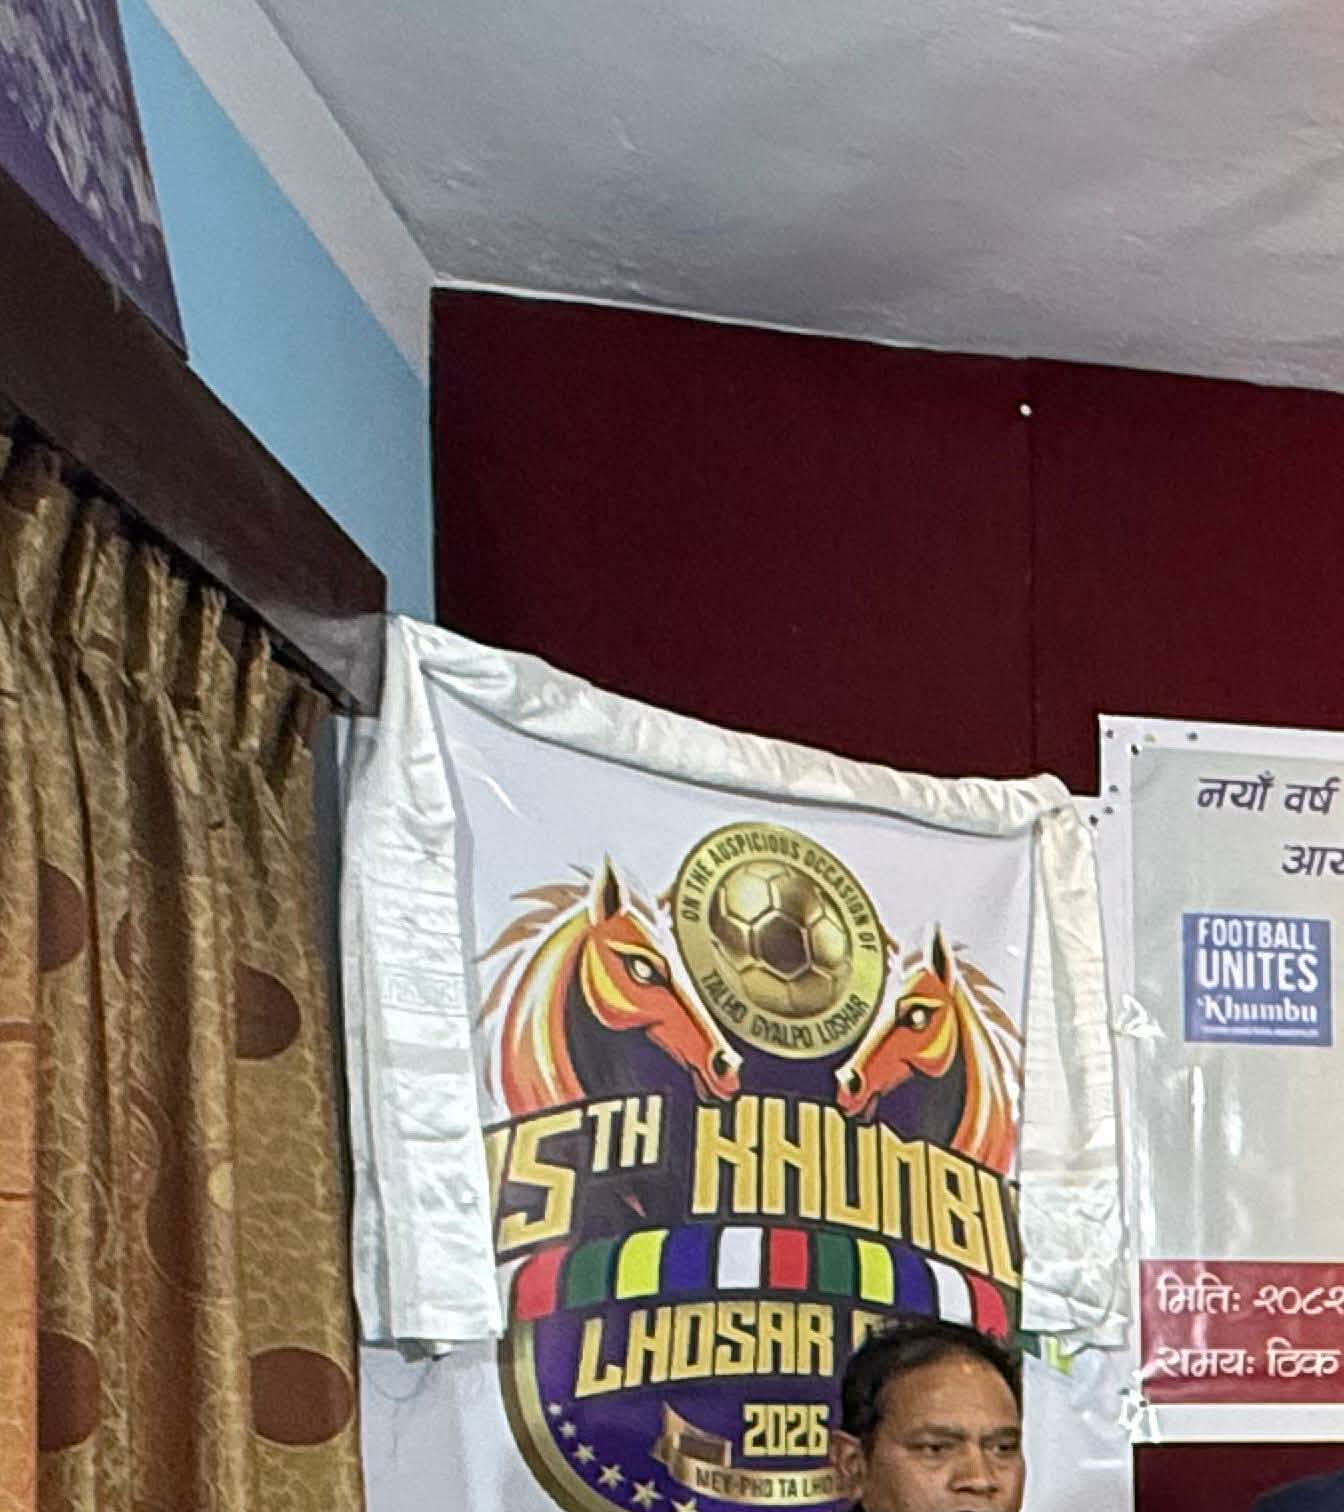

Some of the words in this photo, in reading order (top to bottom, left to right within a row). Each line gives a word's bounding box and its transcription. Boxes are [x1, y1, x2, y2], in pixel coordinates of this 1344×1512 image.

[1199, 771, 1274, 812] नयाँ
[1285, 776, 1341, 815] वर्ष
[706, 831, 800, 867] AUSPICIOUS
[687, 859, 715, 892] THE
[804, 849, 870, 927] OCCASION
[681, 895, 700, 922] ON
[858, 932, 878, 952] OF
[1198, 916, 1317, 950] FOOTBALL
[1198, 948, 1318, 992] UNITES
[1197, 994, 1318, 1024] Khumbu
[751, 1014, 813, 1049] GYALPO
[574, 1301, 834, 1398] LHOSAR
[1266, 1336, 1342, 1379] ठिक
[743, 1404, 831, 1456] 2026
